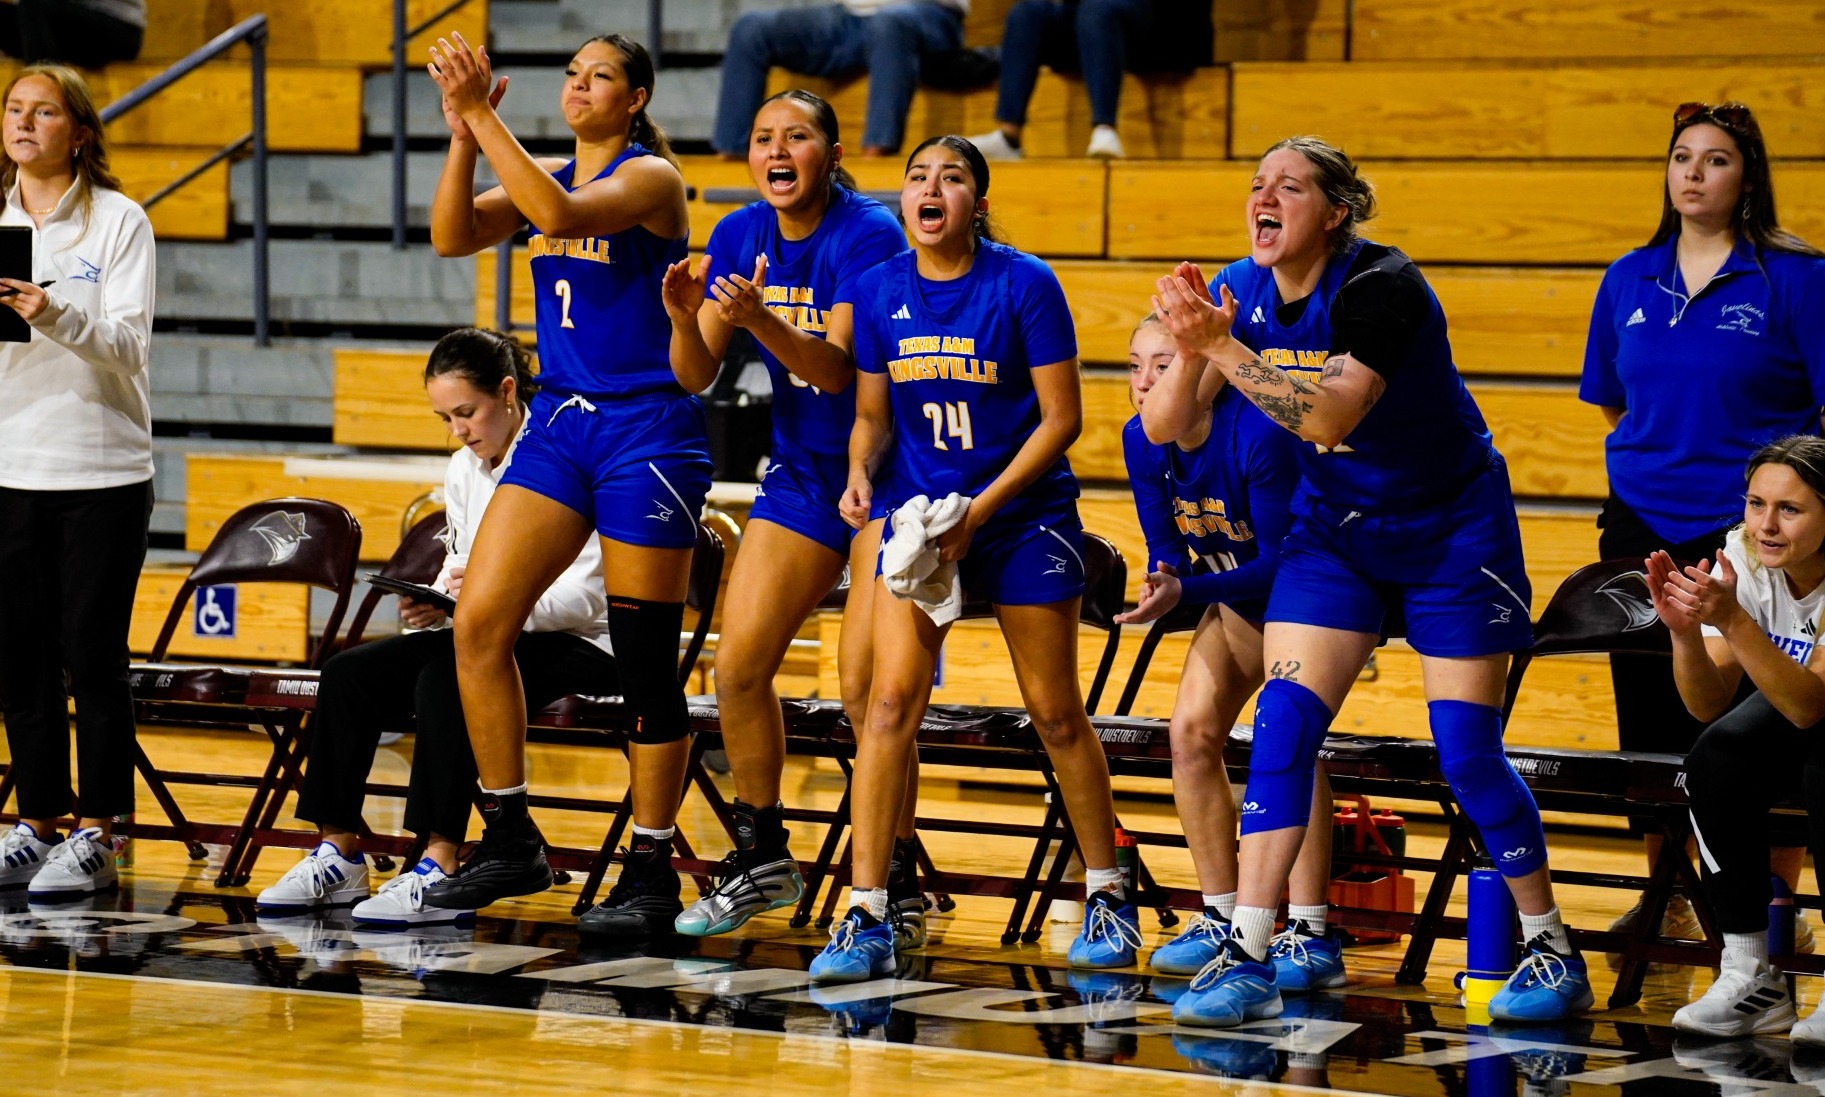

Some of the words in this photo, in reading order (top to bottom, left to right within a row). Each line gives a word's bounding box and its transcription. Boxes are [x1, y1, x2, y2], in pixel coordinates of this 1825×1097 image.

[555, 279, 575, 329] 2
[898, 336, 941, 356] TEXAS
[941, 336, 975, 355] A&M
[922, 401, 974, 451] 24
[1270, 660, 1301, 681] 42
[277, 679, 301, 695] TAMIU
[1100, 728, 1153, 744] DUSTDEVILS
